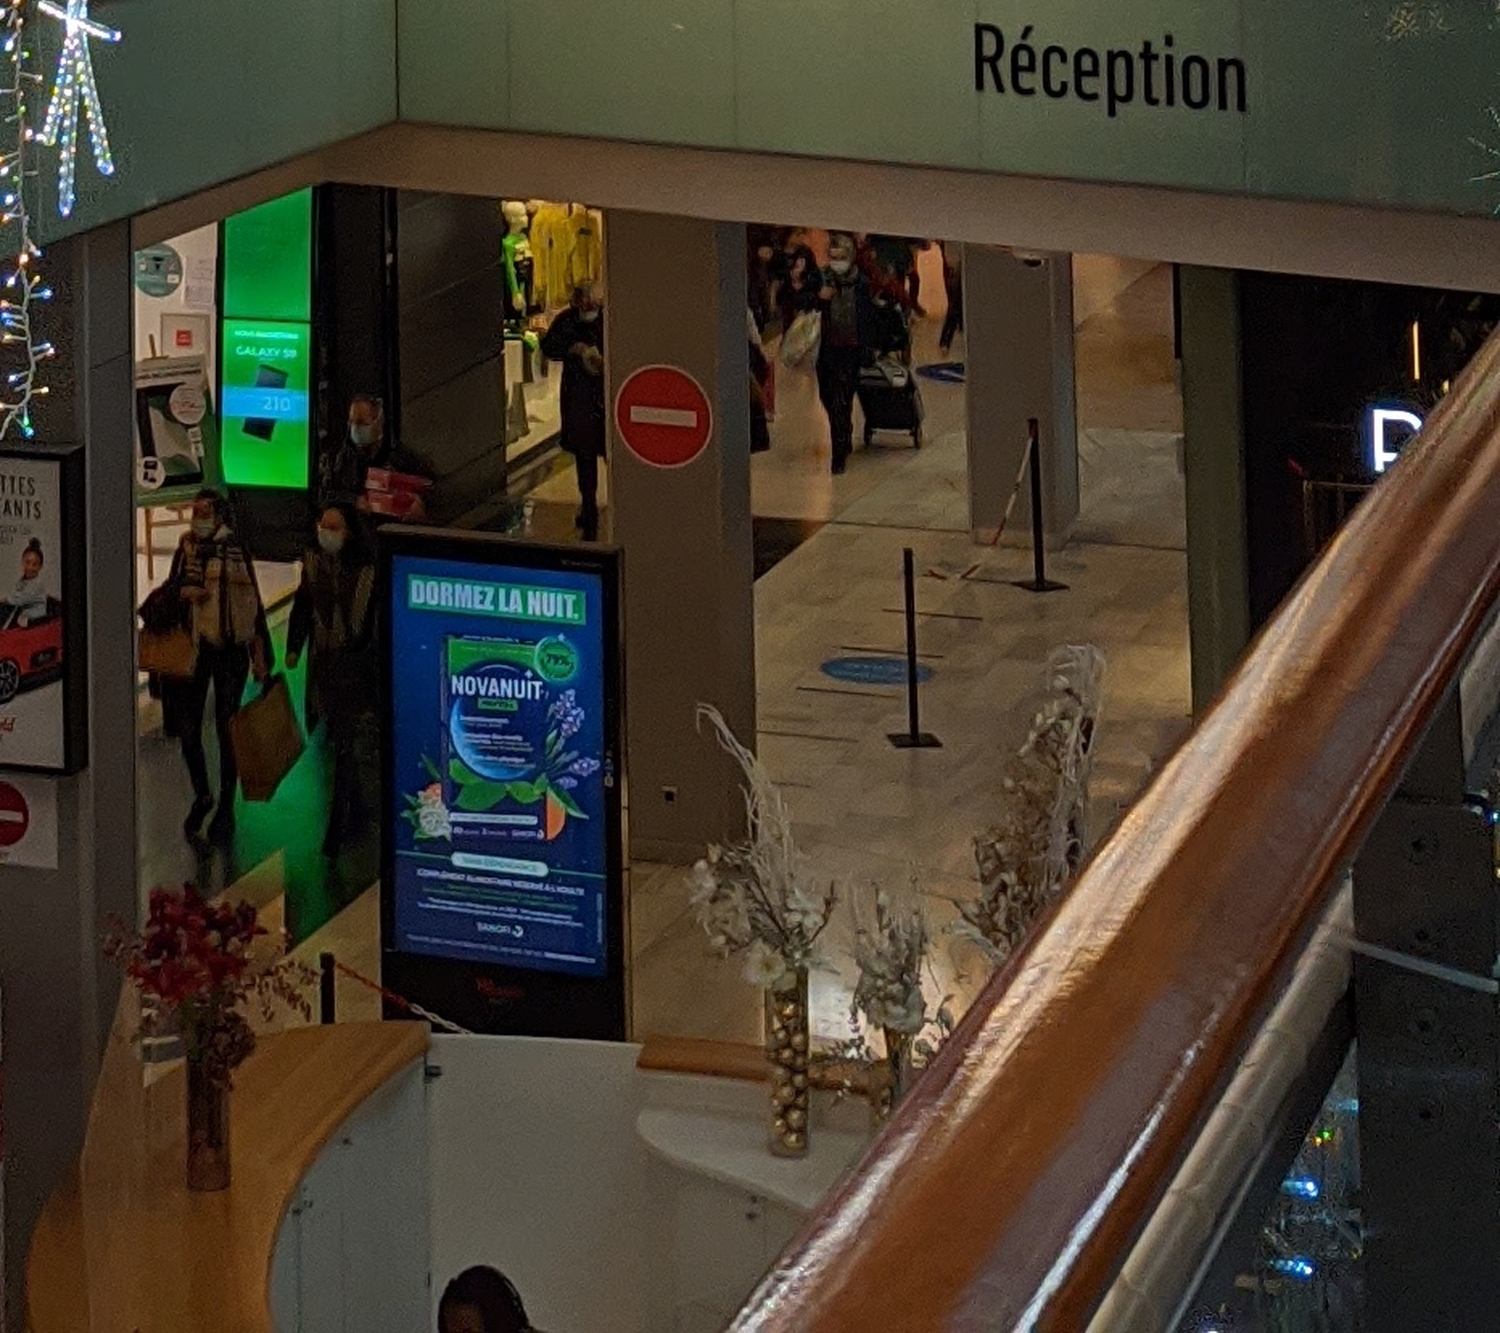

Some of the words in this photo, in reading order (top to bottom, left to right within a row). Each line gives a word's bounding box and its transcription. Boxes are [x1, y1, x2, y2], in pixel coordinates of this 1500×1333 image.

[973, 22, 1248, 117] Réception
[411, 579, 496, 612] DORMEZ
[498, 587, 524, 614] LA
[451, 674, 544, 701] NOVANUIT
